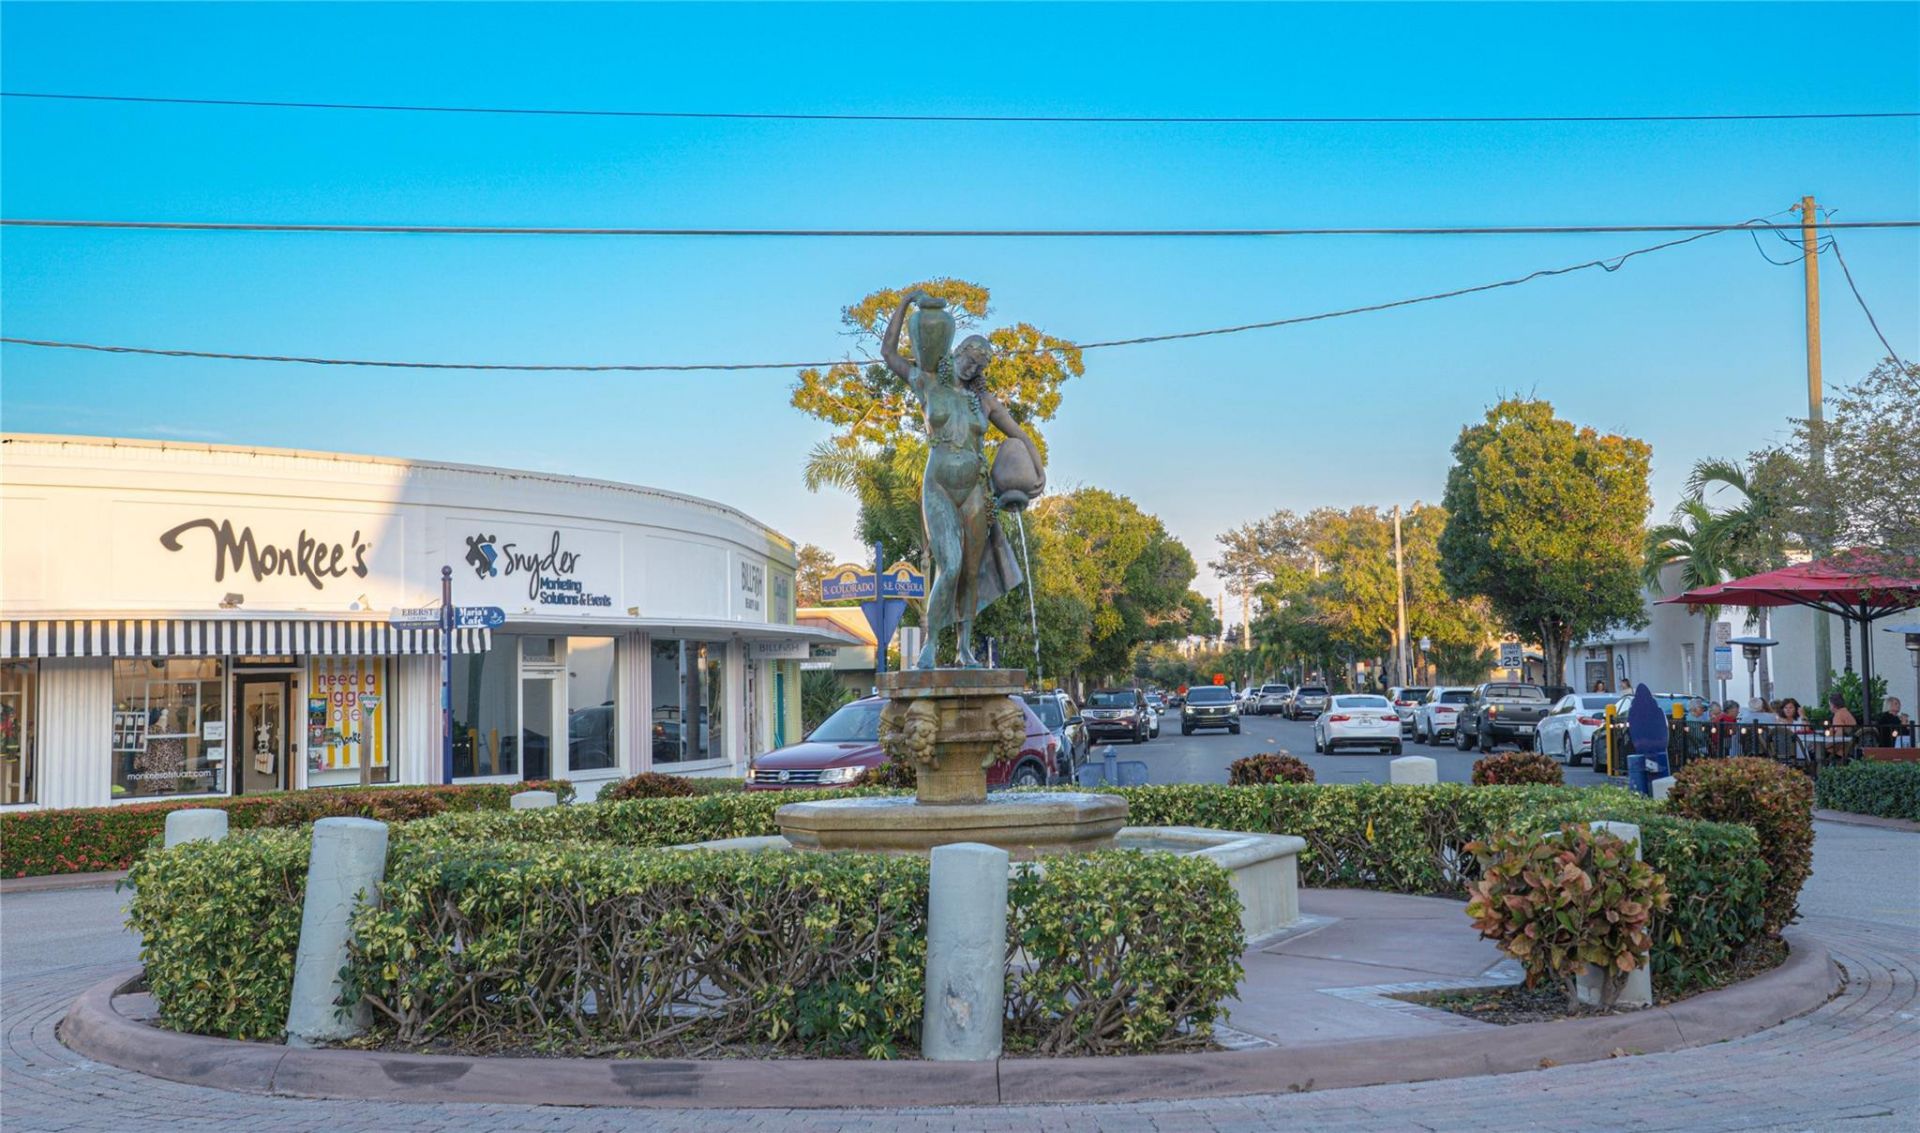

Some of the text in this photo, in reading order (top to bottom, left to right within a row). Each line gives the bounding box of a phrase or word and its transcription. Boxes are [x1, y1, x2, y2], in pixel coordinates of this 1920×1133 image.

[160, 518, 368, 590] Monkee's
[503, 530, 580, 600] Snyder
[540, 577, 582, 593] Marketing
[831, 583, 874, 595] COLORADO
[540, 591, 579, 605] Solutions
[587, 593, 611, 607] Events
[1504, 656, 1520, 667] 25
[318, 671, 376, 686] need a
